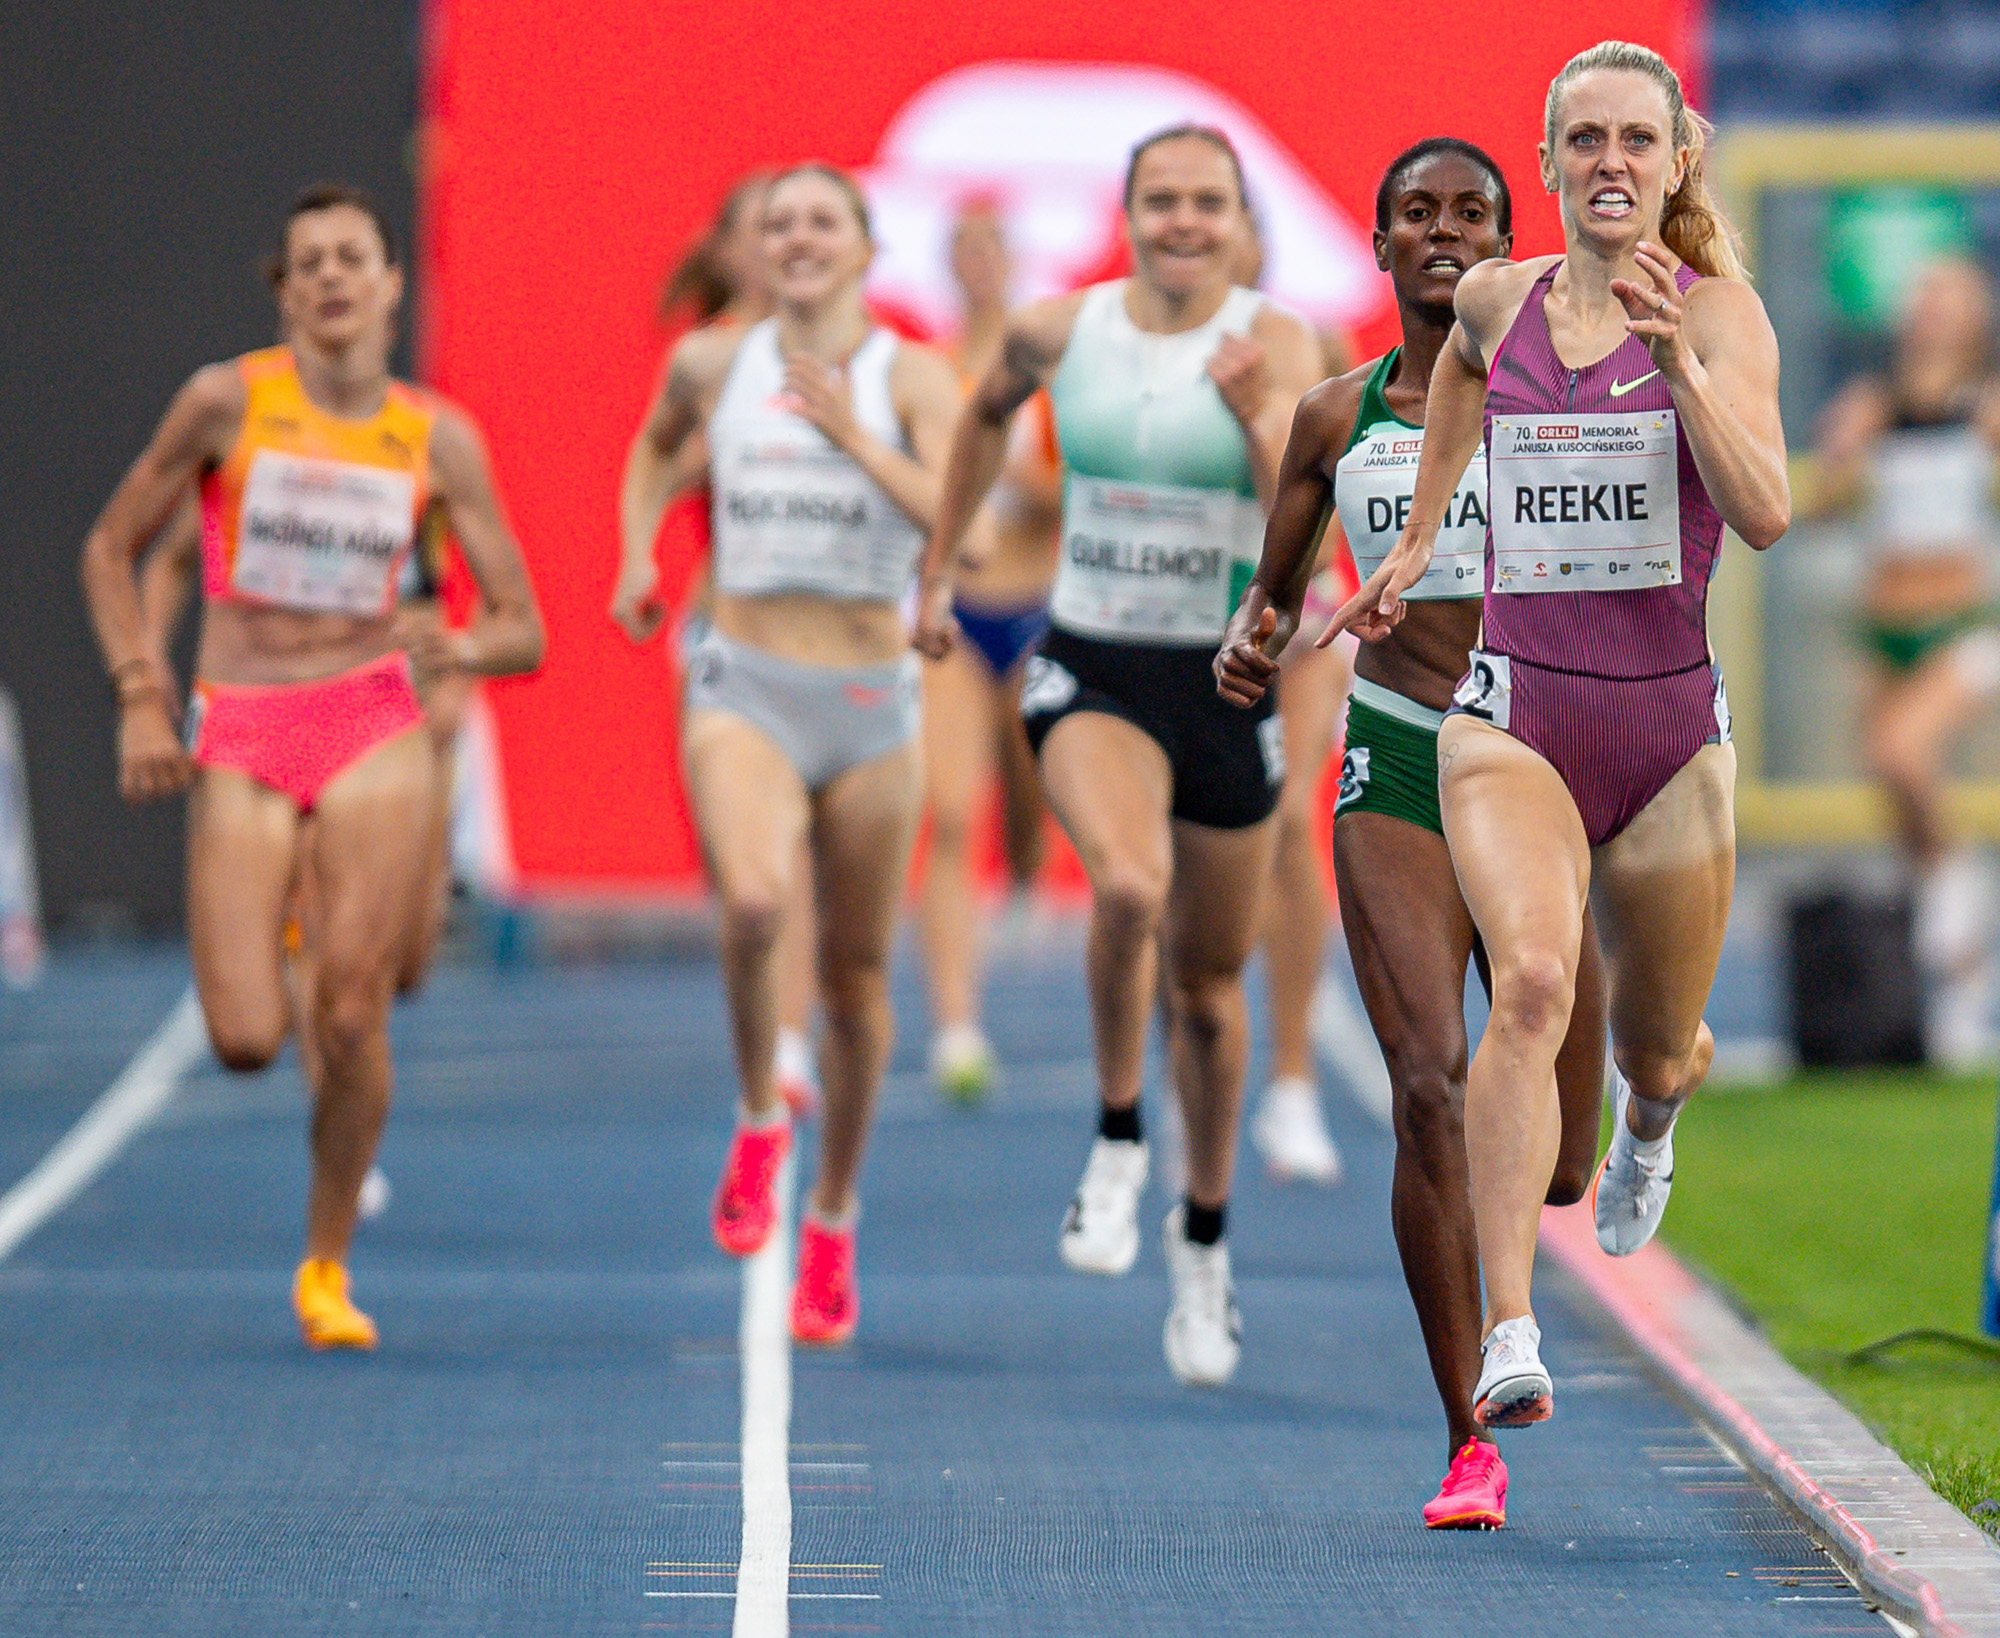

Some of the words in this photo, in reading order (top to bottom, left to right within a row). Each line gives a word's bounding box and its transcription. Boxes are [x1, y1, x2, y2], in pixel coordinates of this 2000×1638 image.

[1516, 427, 1534, 440] 70.
[1538, 426, 1577, 438] ORLEN
[1582, 427, 1640, 437] MEMORIAŁ
[1370, 443, 1389, 455] 70.
[1394, 441, 1424, 453] ORLE
[1513, 442, 1554, 453] JANUSZA
[1557, 440, 1645, 453] KUSOCIŃSKIEGO
[1363, 457, 1408, 467] JANUSZA
[1514, 483, 1649, 523] REEKIE
[1367, 491, 1487, 533] DETA
